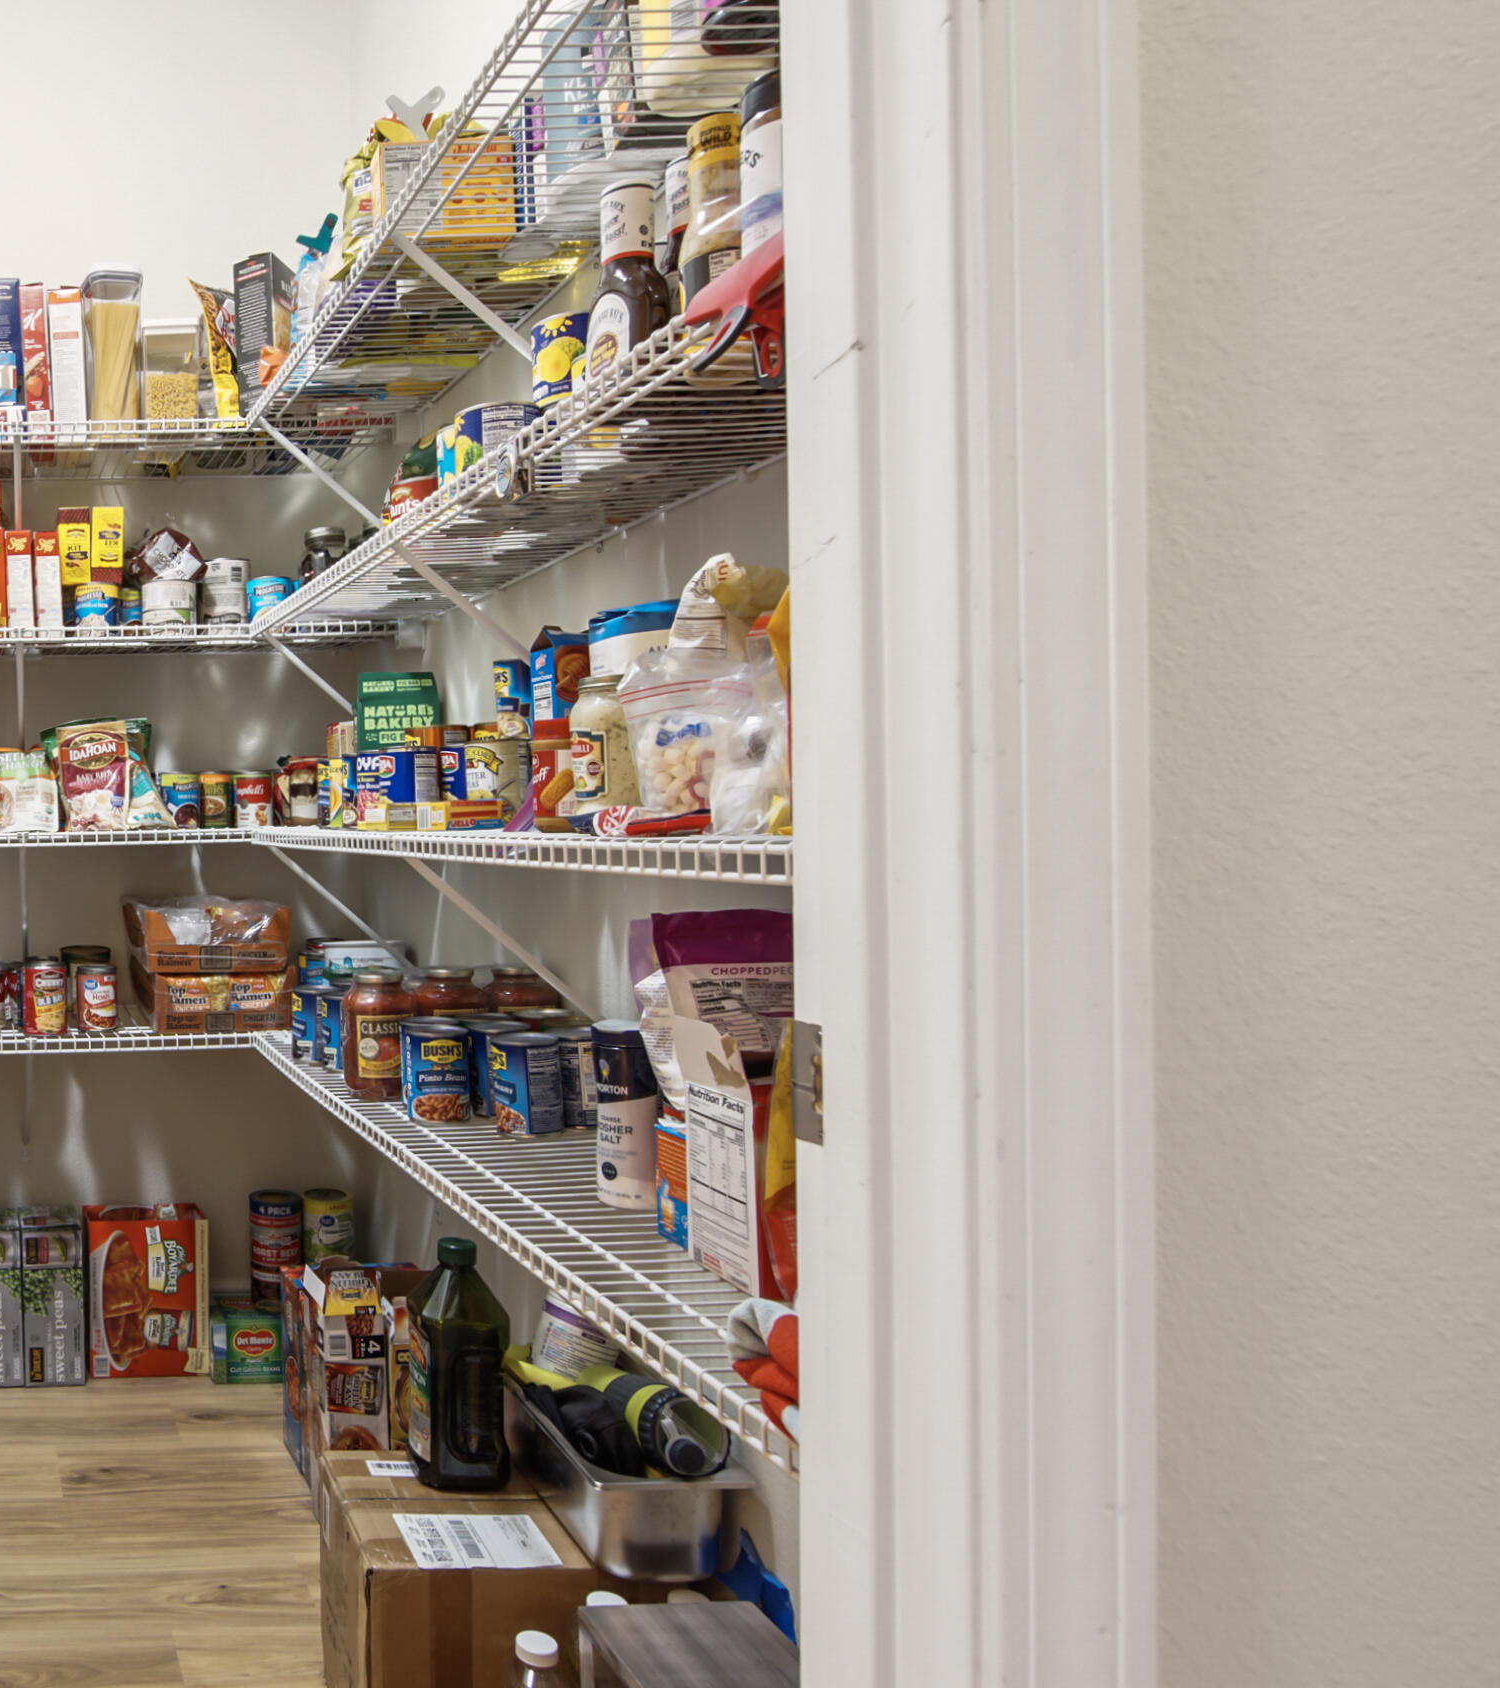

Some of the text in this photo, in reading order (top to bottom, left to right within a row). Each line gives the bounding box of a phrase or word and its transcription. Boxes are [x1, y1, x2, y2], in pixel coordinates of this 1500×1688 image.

[701, 132, 732, 147] WILD
[364, 716, 434, 730] BAKERY
[381, 733, 397, 741] FIG
[69, 742, 116, 761] IDAHOAN
[711, 967, 771, 976] CHOPPED
[231, 982, 251, 993] Top
[230, 992, 272, 1001] Ramen
[360, 1020, 400, 1034] CLASSI
[423, 1044, 462, 1057] BUSH'S
[418, 1073, 443, 1083] Pinto
[688, 1083, 744, 1114] Nutrition Facts
[598, 1121, 634, 1136] OSHER
[599, 1132, 622, 1145] SALT
[267, 1206, 292, 1216] PACK
[164, 1240, 178, 1294] BOYARDEE
[53, 1290, 67, 1383] sweet peas
[236, 1336, 273, 1345] Del Monte
[366, 1339, 381, 1354] 4
